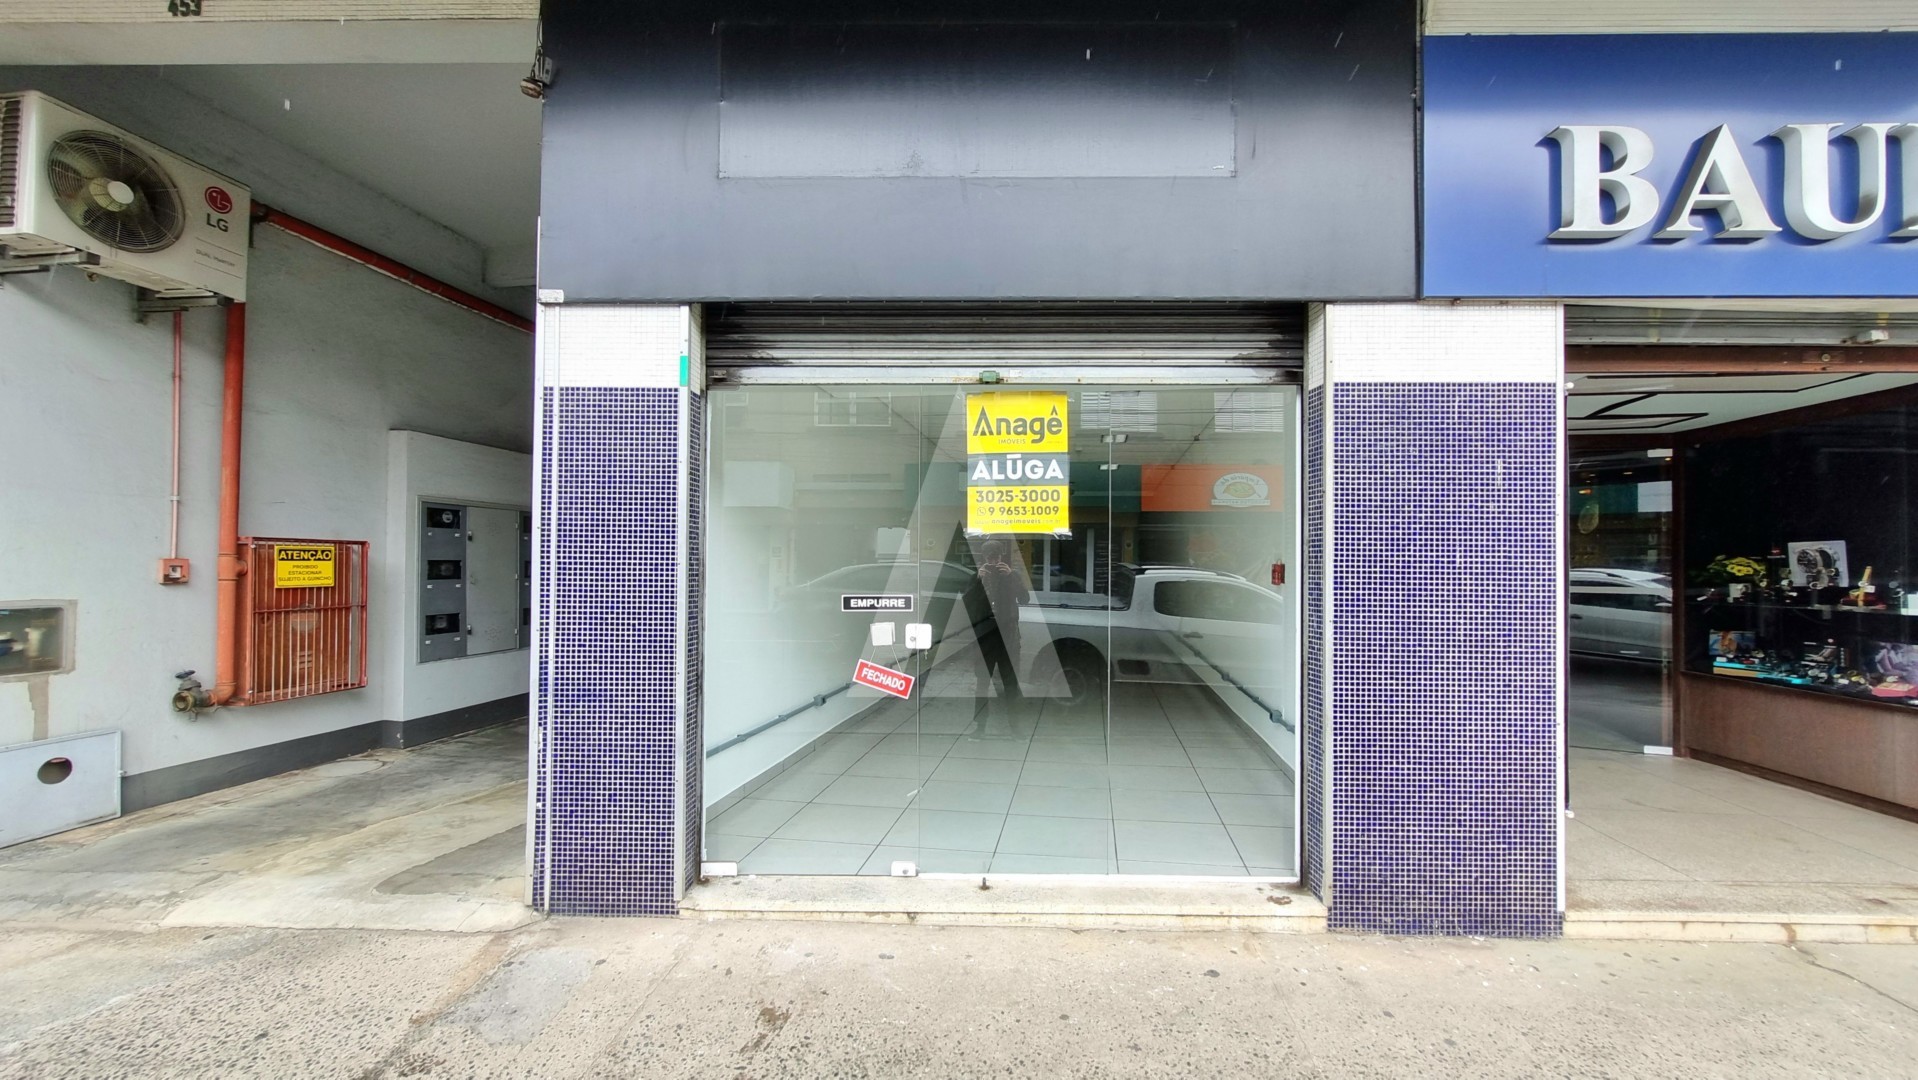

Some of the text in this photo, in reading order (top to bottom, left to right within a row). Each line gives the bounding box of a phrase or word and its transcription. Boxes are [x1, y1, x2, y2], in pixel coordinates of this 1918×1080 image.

[168, 0, 202, 17] 453
[1546, 123, 1918, 241] BAU
[206, 212, 229, 233] LG
[972, 405, 1063, 444] Anagê
[976, 489, 1061, 503] 3025-3000
[988, 505, 1060, 516] 9 9653-1009
[279, 549, 332, 561] ATENÇÃO
[850, 598, 906, 608] EMPURRE
[861, 667, 906, 691] FECHADO
